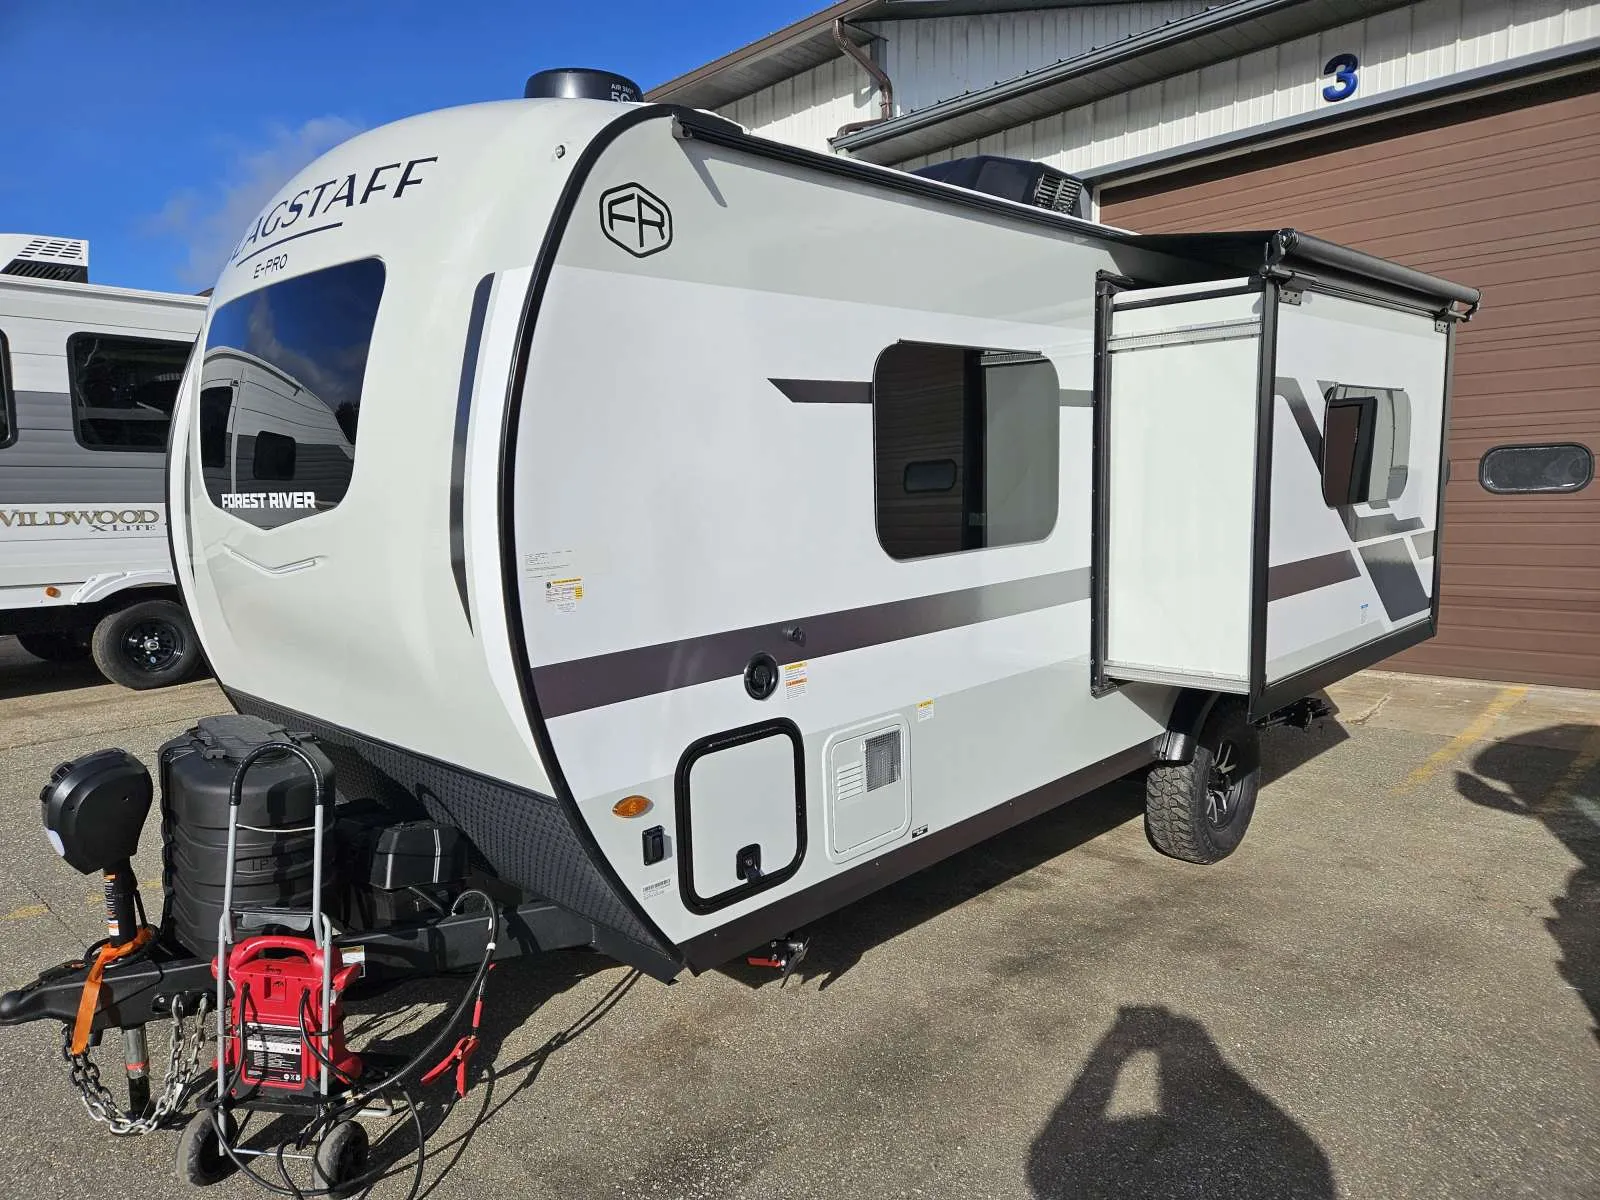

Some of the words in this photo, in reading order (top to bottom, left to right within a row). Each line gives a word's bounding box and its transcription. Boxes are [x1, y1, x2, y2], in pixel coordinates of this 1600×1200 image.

[1323, 53, 1358, 102] 3
[231, 156, 438, 262] LAGSTAFF
[253, 253, 288, 279] E-PRO
[221, 493, 266, 509] FOREST
[268, 491, 316, 509] RIVER
[90, 524, 107, 532] X
[113, 524, 156, 532] LITE
